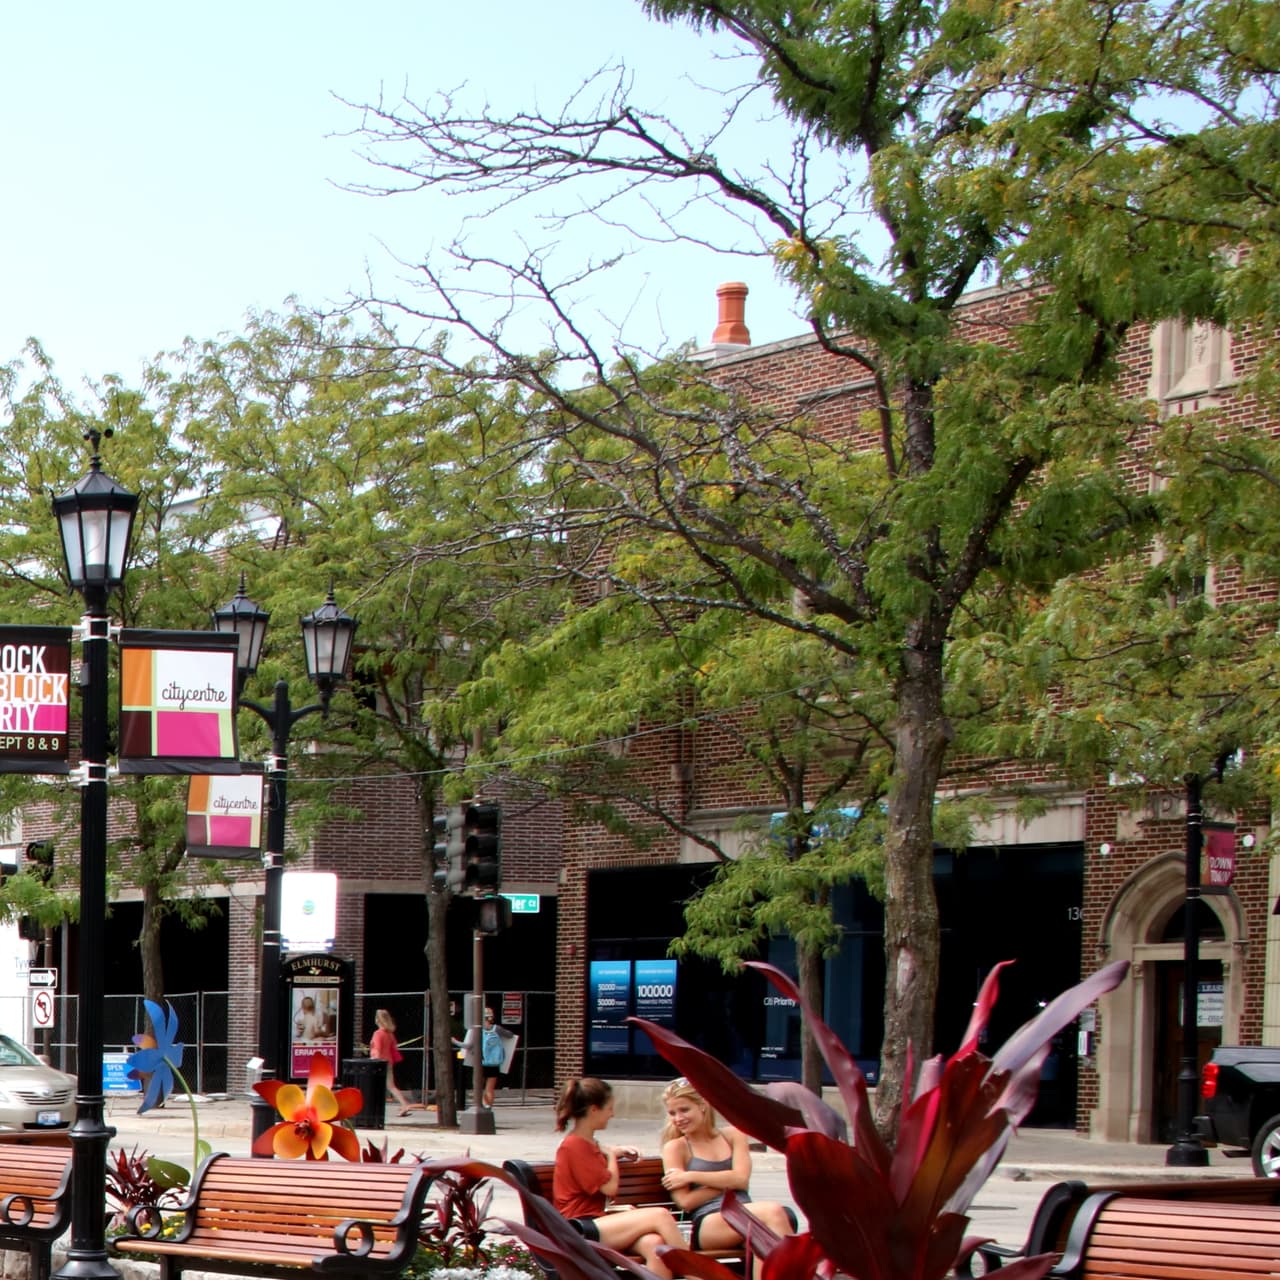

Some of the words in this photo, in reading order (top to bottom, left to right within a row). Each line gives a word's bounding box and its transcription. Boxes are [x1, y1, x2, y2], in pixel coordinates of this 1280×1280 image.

[161, 680, 228, 711] citycentre
[26, 737, 35, 750] 8
[38, 737, 48, 751] &
[51, 738, 60, 751] 9
[213, 795, 258, 814] citycentre
[291, 958, 341, 971] ELMHURST
